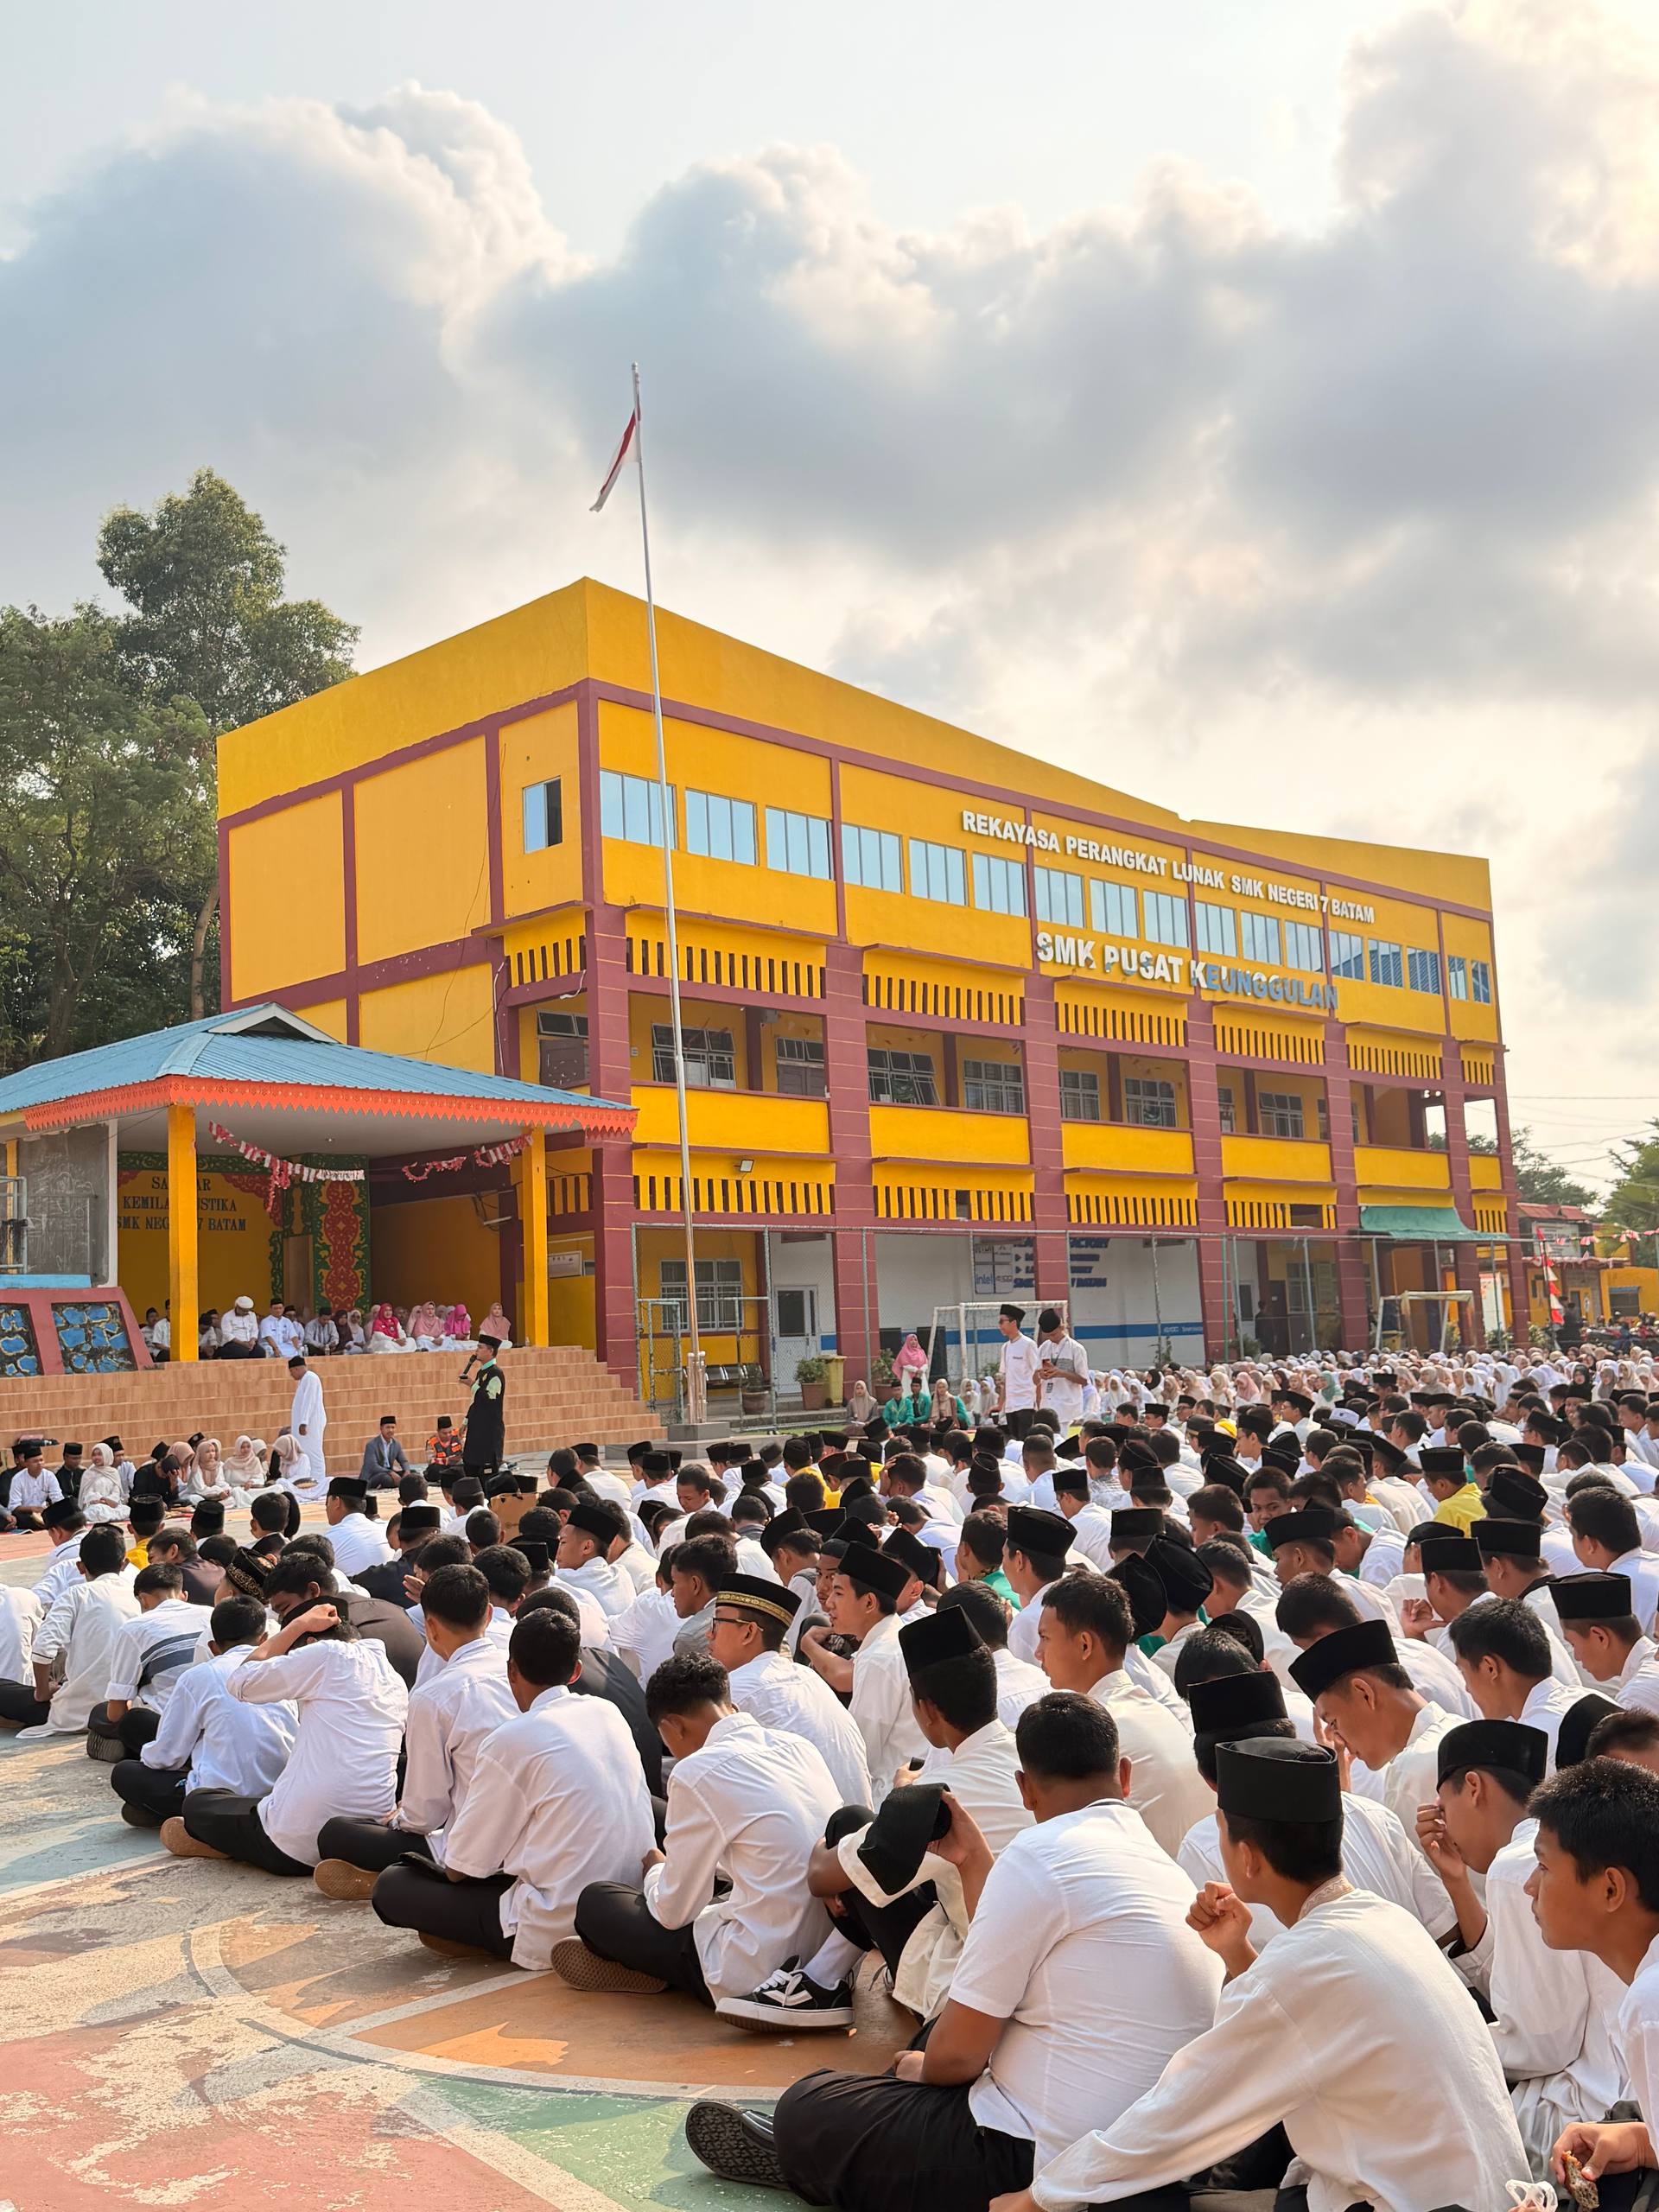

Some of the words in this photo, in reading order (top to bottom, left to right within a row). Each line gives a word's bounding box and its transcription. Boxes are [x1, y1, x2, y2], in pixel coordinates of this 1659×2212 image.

[962, 810, 1060, 854] REKAYASA
[1065, 836, 1167, 876] PERANGKAT
[1172, 861, 1225, 890] LUNAK
[1230, 874, 1264, 899] SMK
[1268, 883, 1319, 911] NEGERI
[1319, 895, 1329, 912] 7
[1331, 899, 1375, 924] BATAM
[1036, 931, 1096, 969] SMK
[1103, 944, 1184, 984] PUSAT
[1189, 959, 1338, 1010] KEUNGGULAN
[208, 1218, 246, 1231] BATAM
